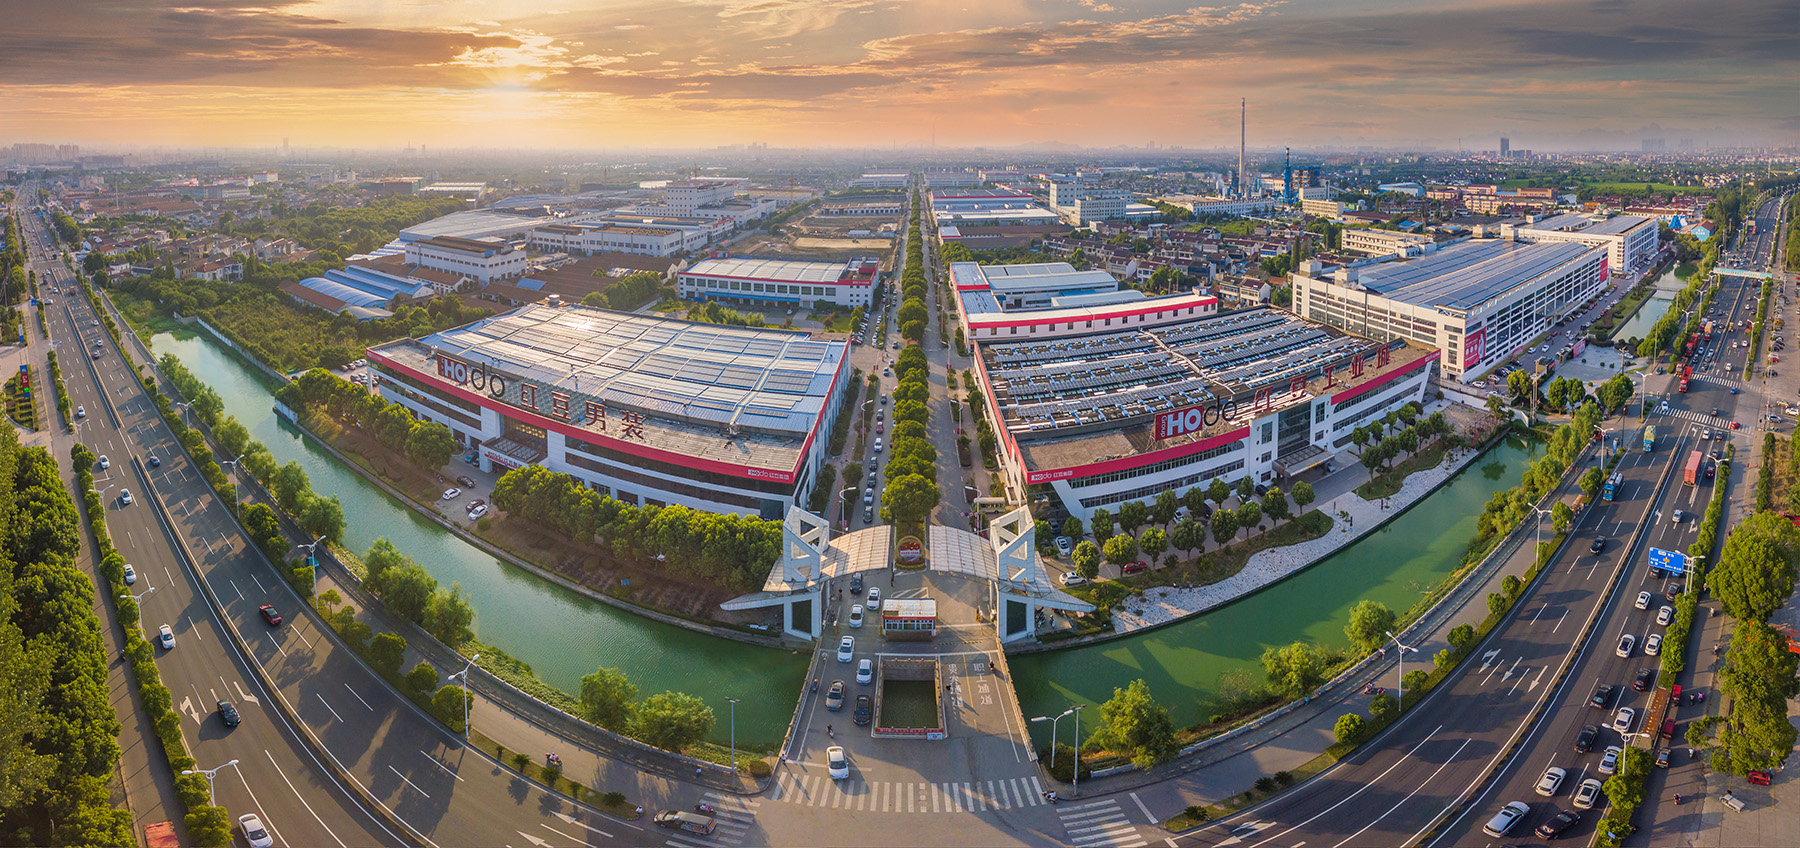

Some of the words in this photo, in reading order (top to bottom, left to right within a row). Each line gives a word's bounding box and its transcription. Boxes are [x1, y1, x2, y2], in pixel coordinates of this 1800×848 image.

[521, 383, 644, 440] 红豆男装
[973, 662, 993, 705] 职工通道
